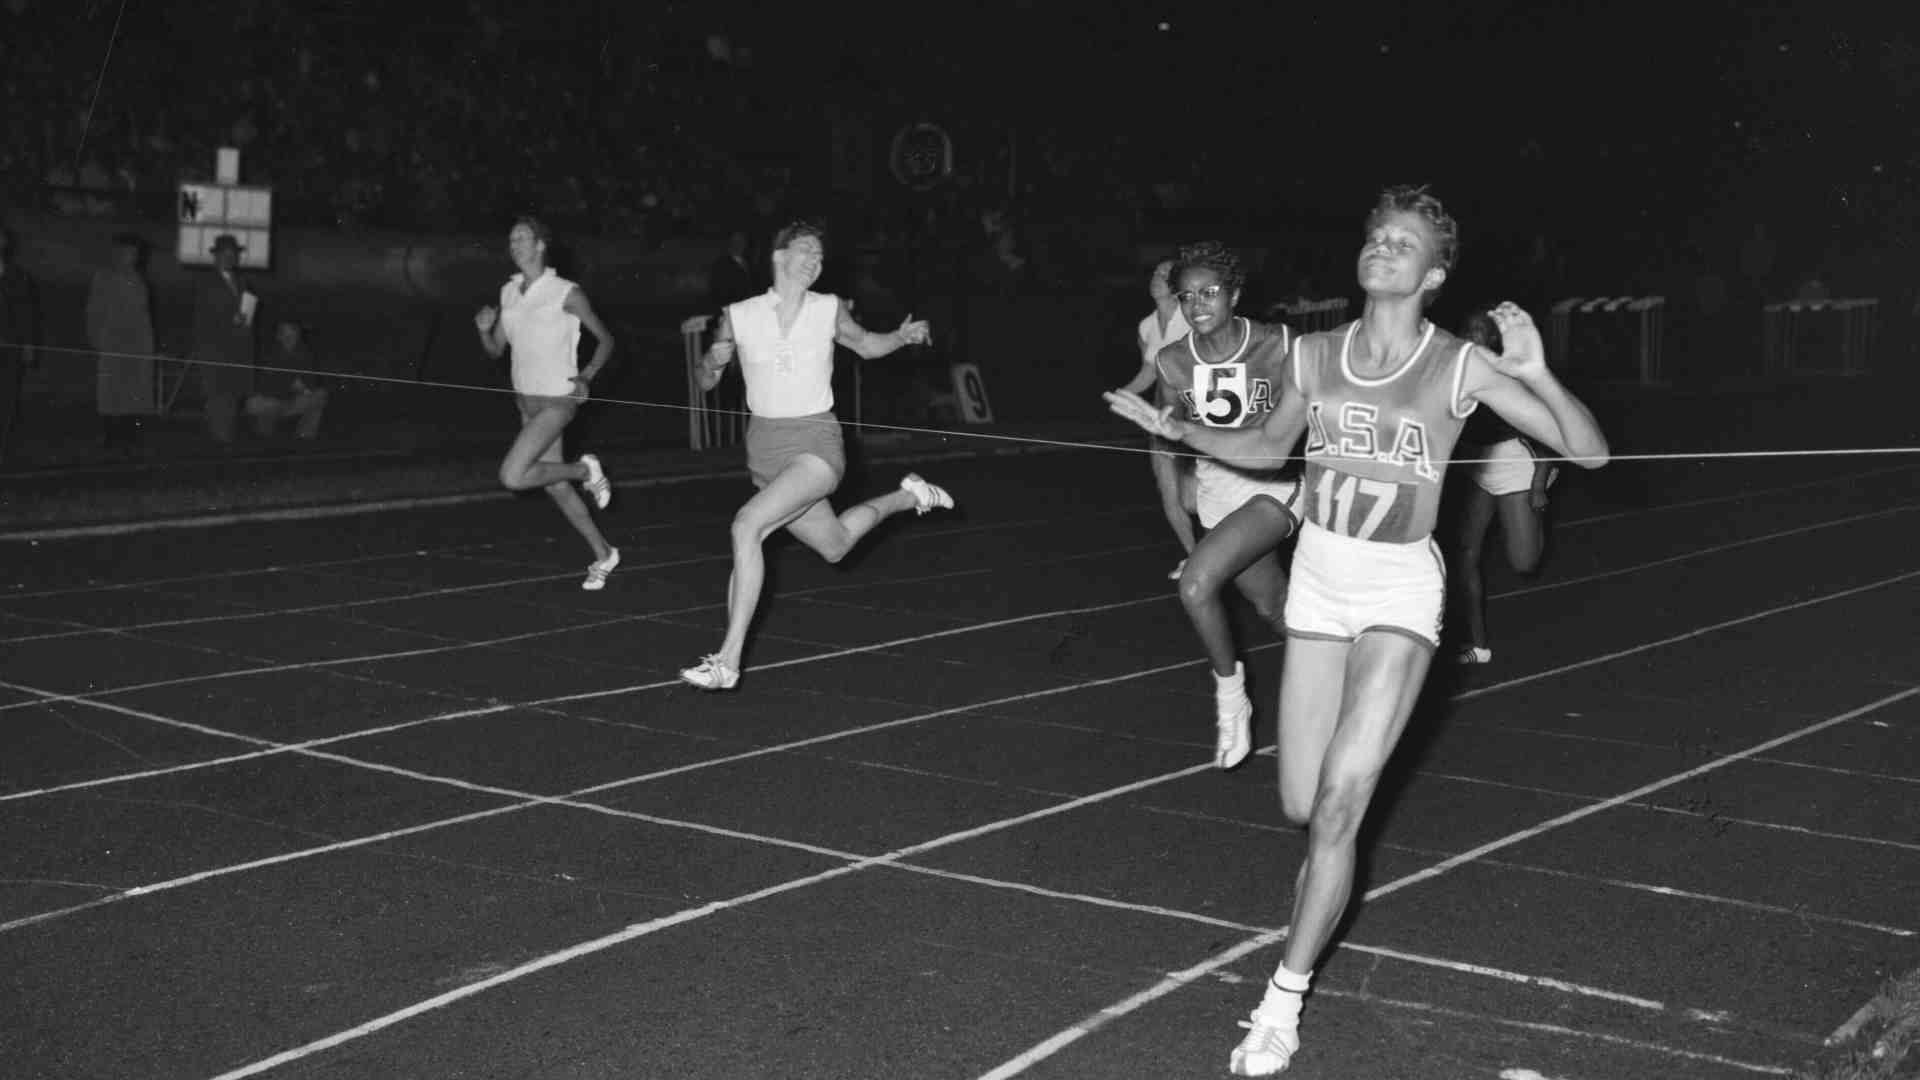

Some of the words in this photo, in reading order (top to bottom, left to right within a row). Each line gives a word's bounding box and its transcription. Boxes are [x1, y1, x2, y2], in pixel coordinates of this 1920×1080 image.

[964, 371, 987, 418] 9
[1206, 367, 1242, 424] 5
[1315, 468, 1398, 540] 117
